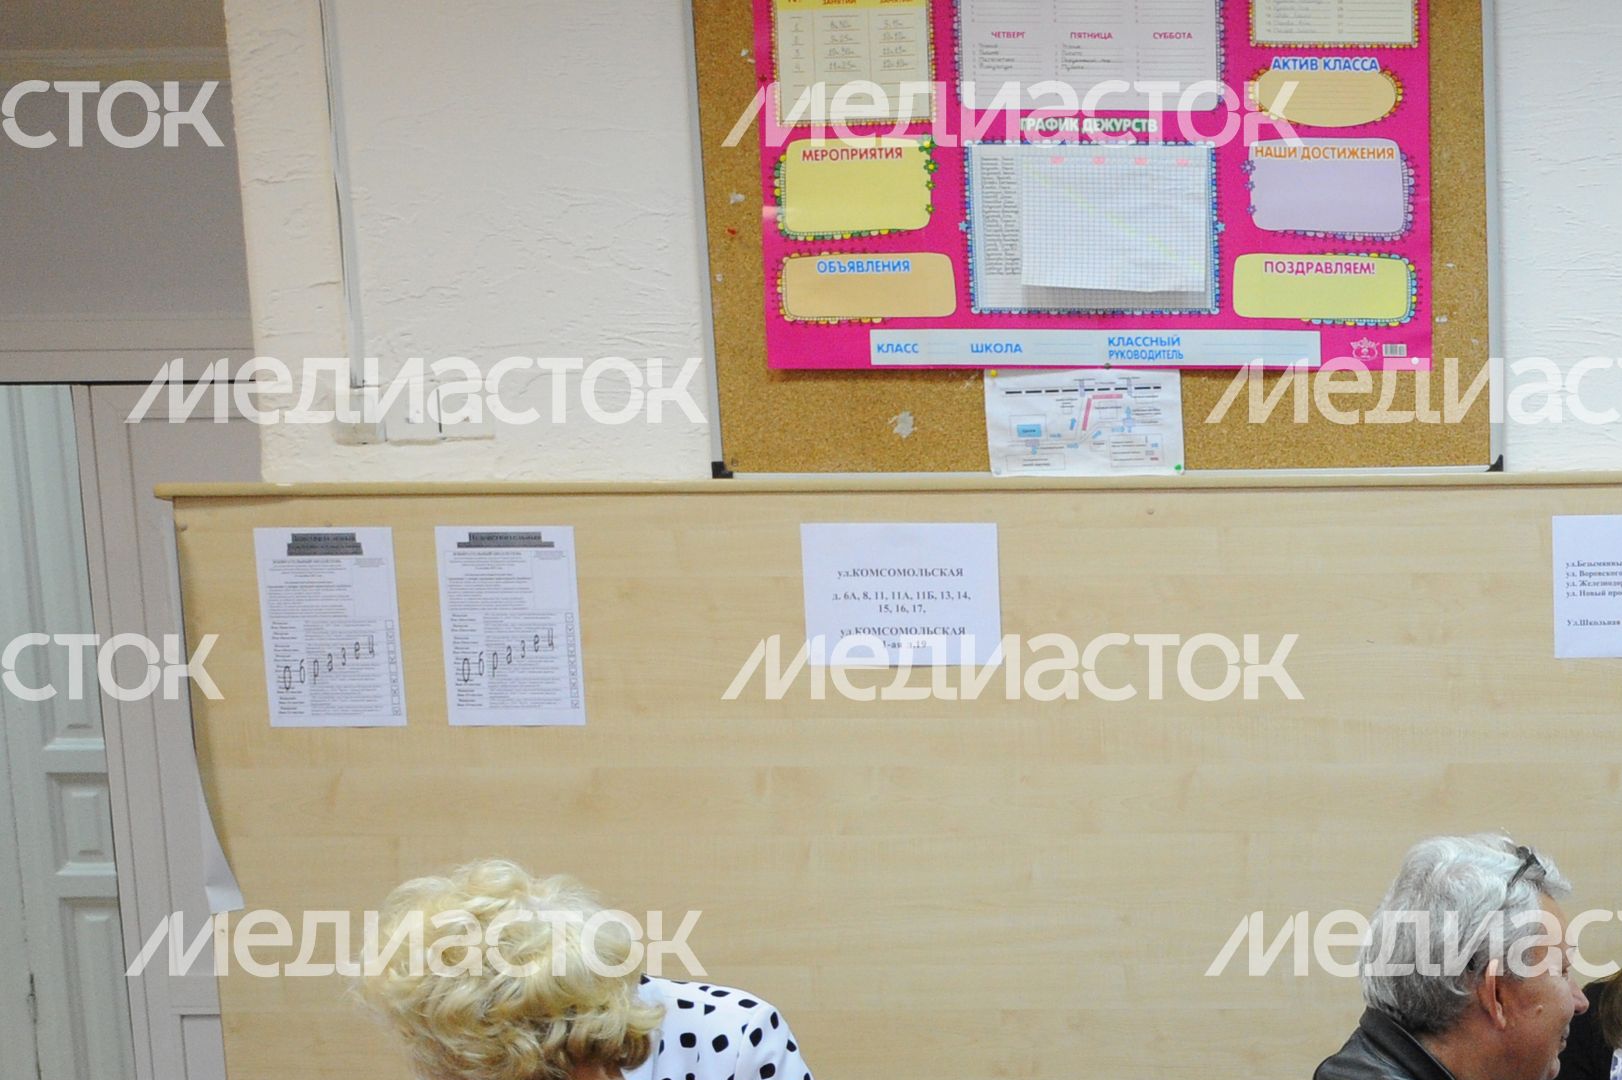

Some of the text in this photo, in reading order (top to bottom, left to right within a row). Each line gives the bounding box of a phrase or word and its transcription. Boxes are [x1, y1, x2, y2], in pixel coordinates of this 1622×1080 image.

[991, 31, 1026, 40] ЧЕТВЕРГ
[1070, 32, 1114, 41] ПЯТНИЦА
[1153, 32, 1193, 40] СУББОТА
[1272, 58, 1378, 71] АКТИВ КЛАССА
[1021, 116, 1079, 132] ГРАФИК
[802, 147, 903, 161] МЕРОПРИЯТИЯ
[1255, 146, 1395, 160] НАШИ ДОСТИЖЕНИЯ
[817, 259, 911, 273] ОБЪЯВЛЕНИЯ
[1264, 261, 1376, 275] ПОЗДРАВЛЯЕМ!
[1108, 334, 1181, 347] КЛАССНЫЙ
[876, 343, 1023, 354] КЛАСС ШКОЛА
[1108, 349, 1184, 361] РУКОВОДИТЕЛЬ
